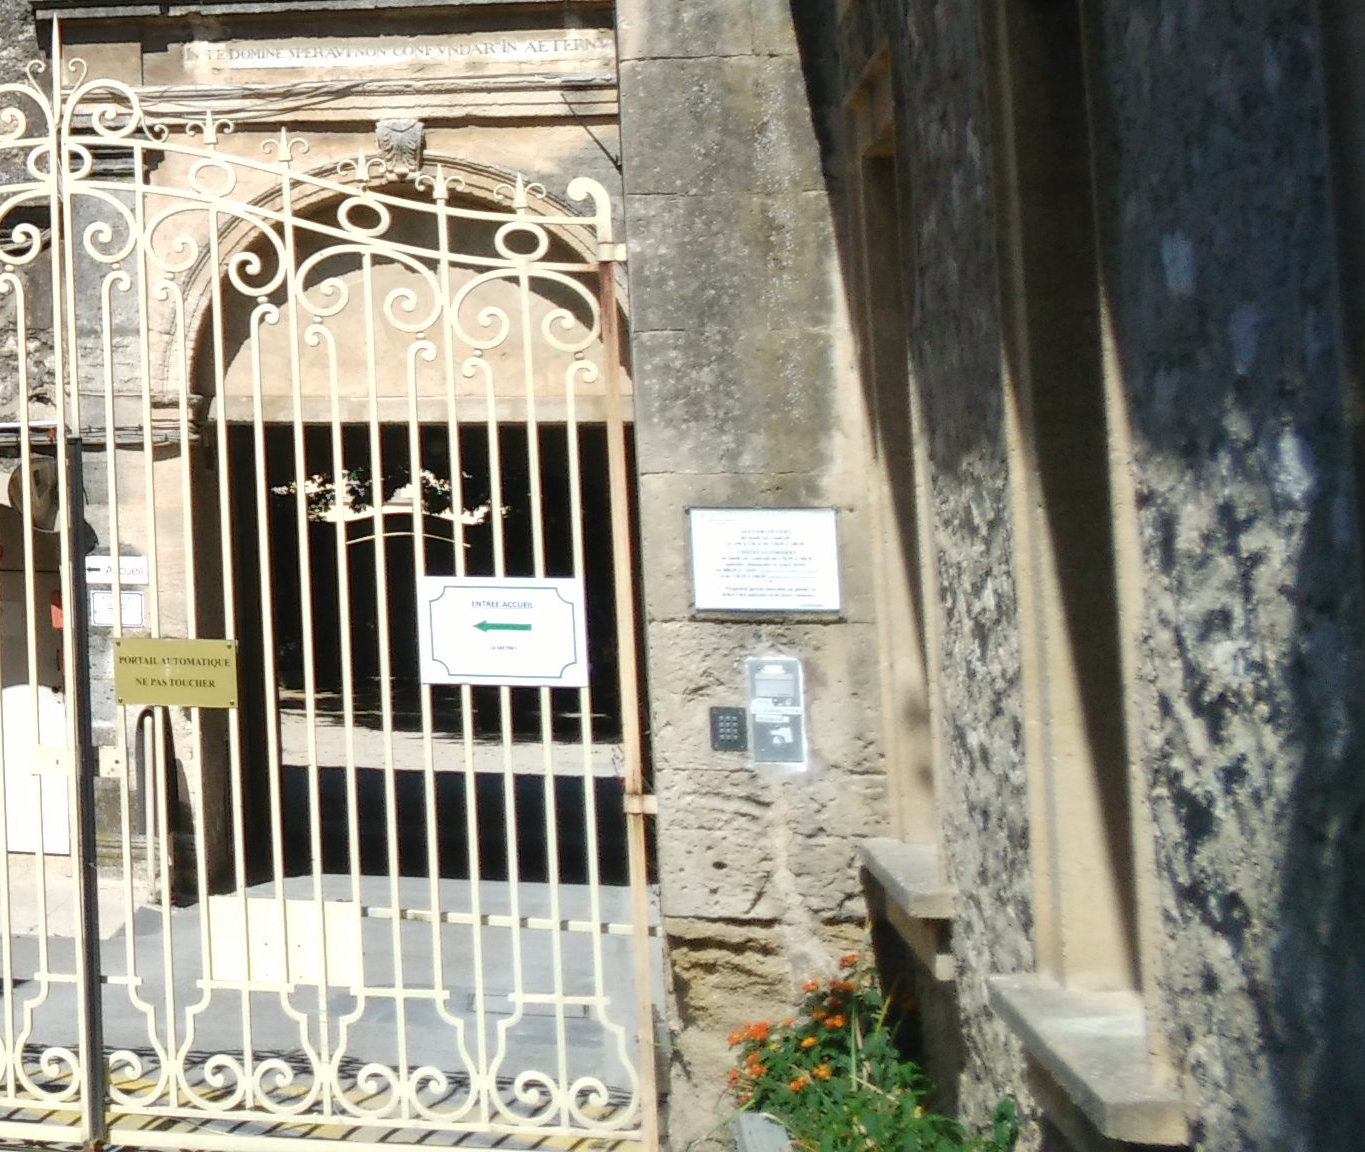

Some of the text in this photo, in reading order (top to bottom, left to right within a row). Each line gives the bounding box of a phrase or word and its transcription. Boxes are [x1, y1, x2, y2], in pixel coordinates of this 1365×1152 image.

[229, 47, 284, 60] DOMINE
[355, 46, 387, 58] NON
[106, 565, 144, 576] Acueil
[502, 601, 533, 610] ACCUEIL
[118, 656, 231, 668] PORTAIL AUTOMATIQUE
[135, 677, 216, 688] NE PAS TOUCHER
